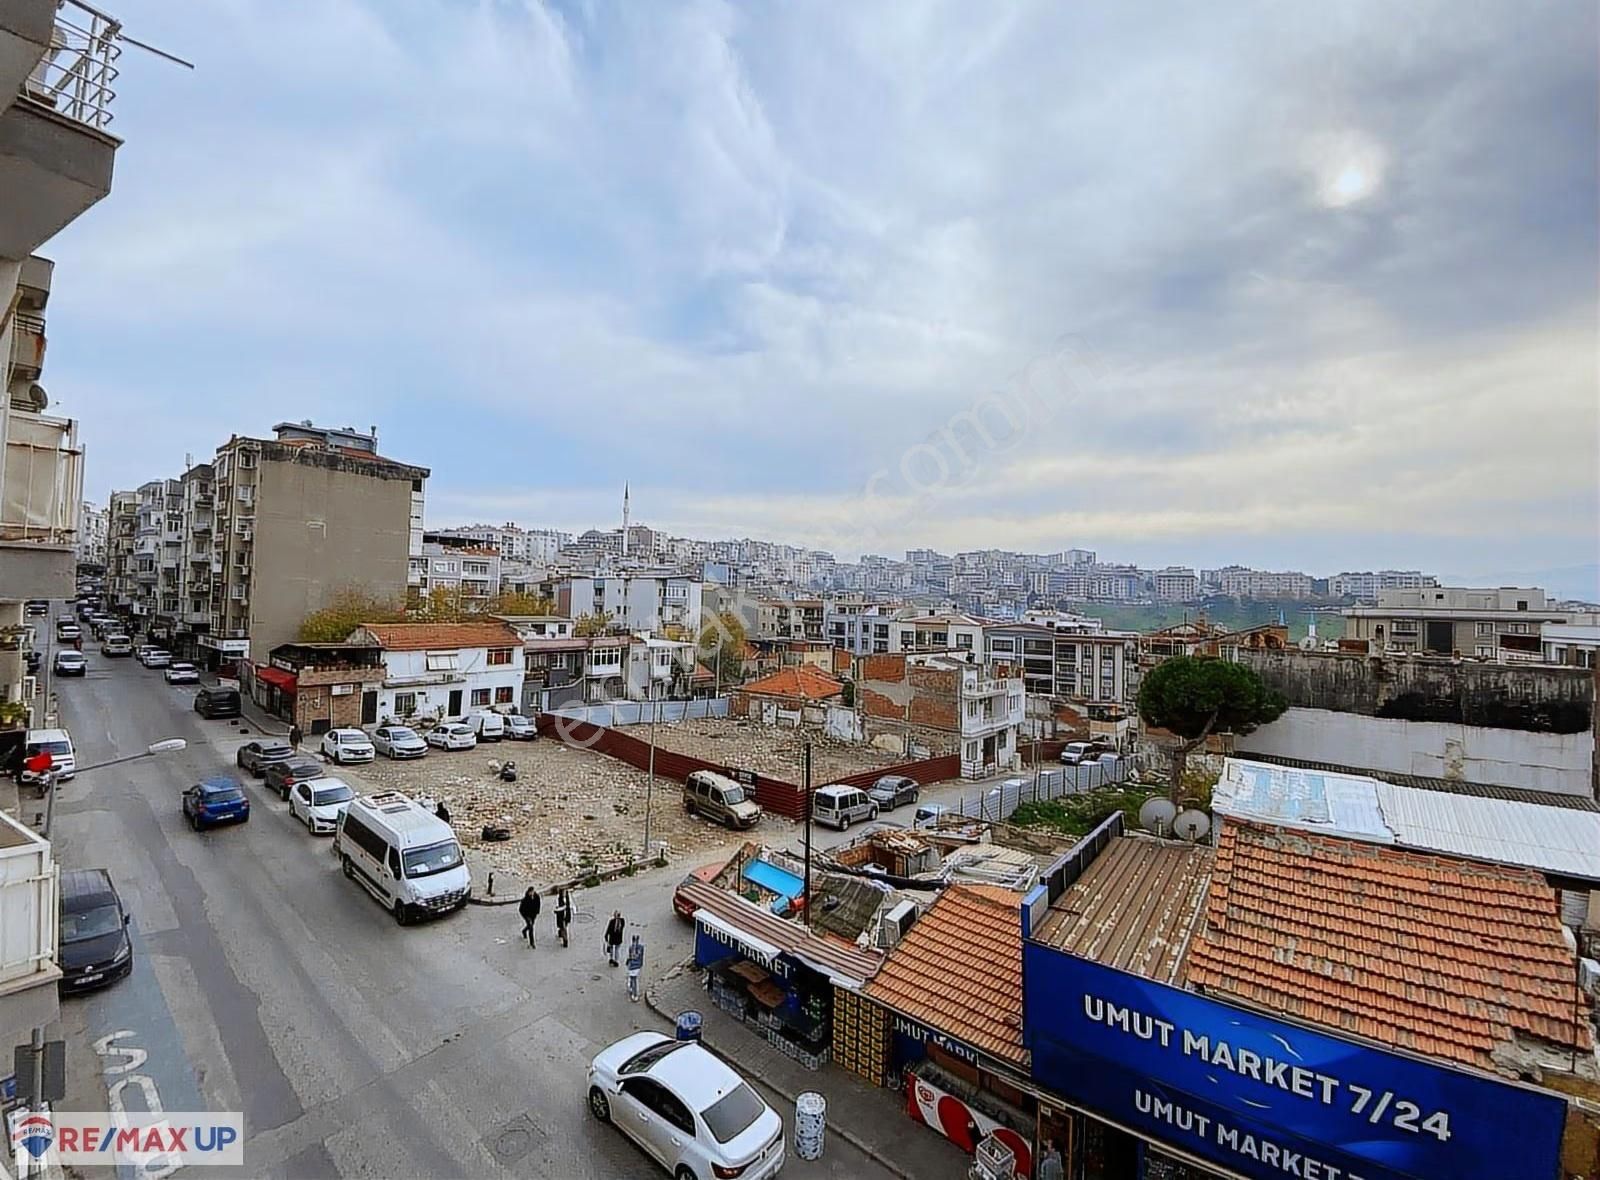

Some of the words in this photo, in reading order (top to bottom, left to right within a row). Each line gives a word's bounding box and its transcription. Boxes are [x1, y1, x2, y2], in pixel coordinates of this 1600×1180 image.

[1085, 994, 1174, 1047] UMUT
[1183, 1029, 1339, 1104] MARKET
[1349, 1084, 1451, 1141] 7/24
[1135, 1089, 1210, 1138] UMUT
[1217, 1123, 1341, 1180] MARKET
